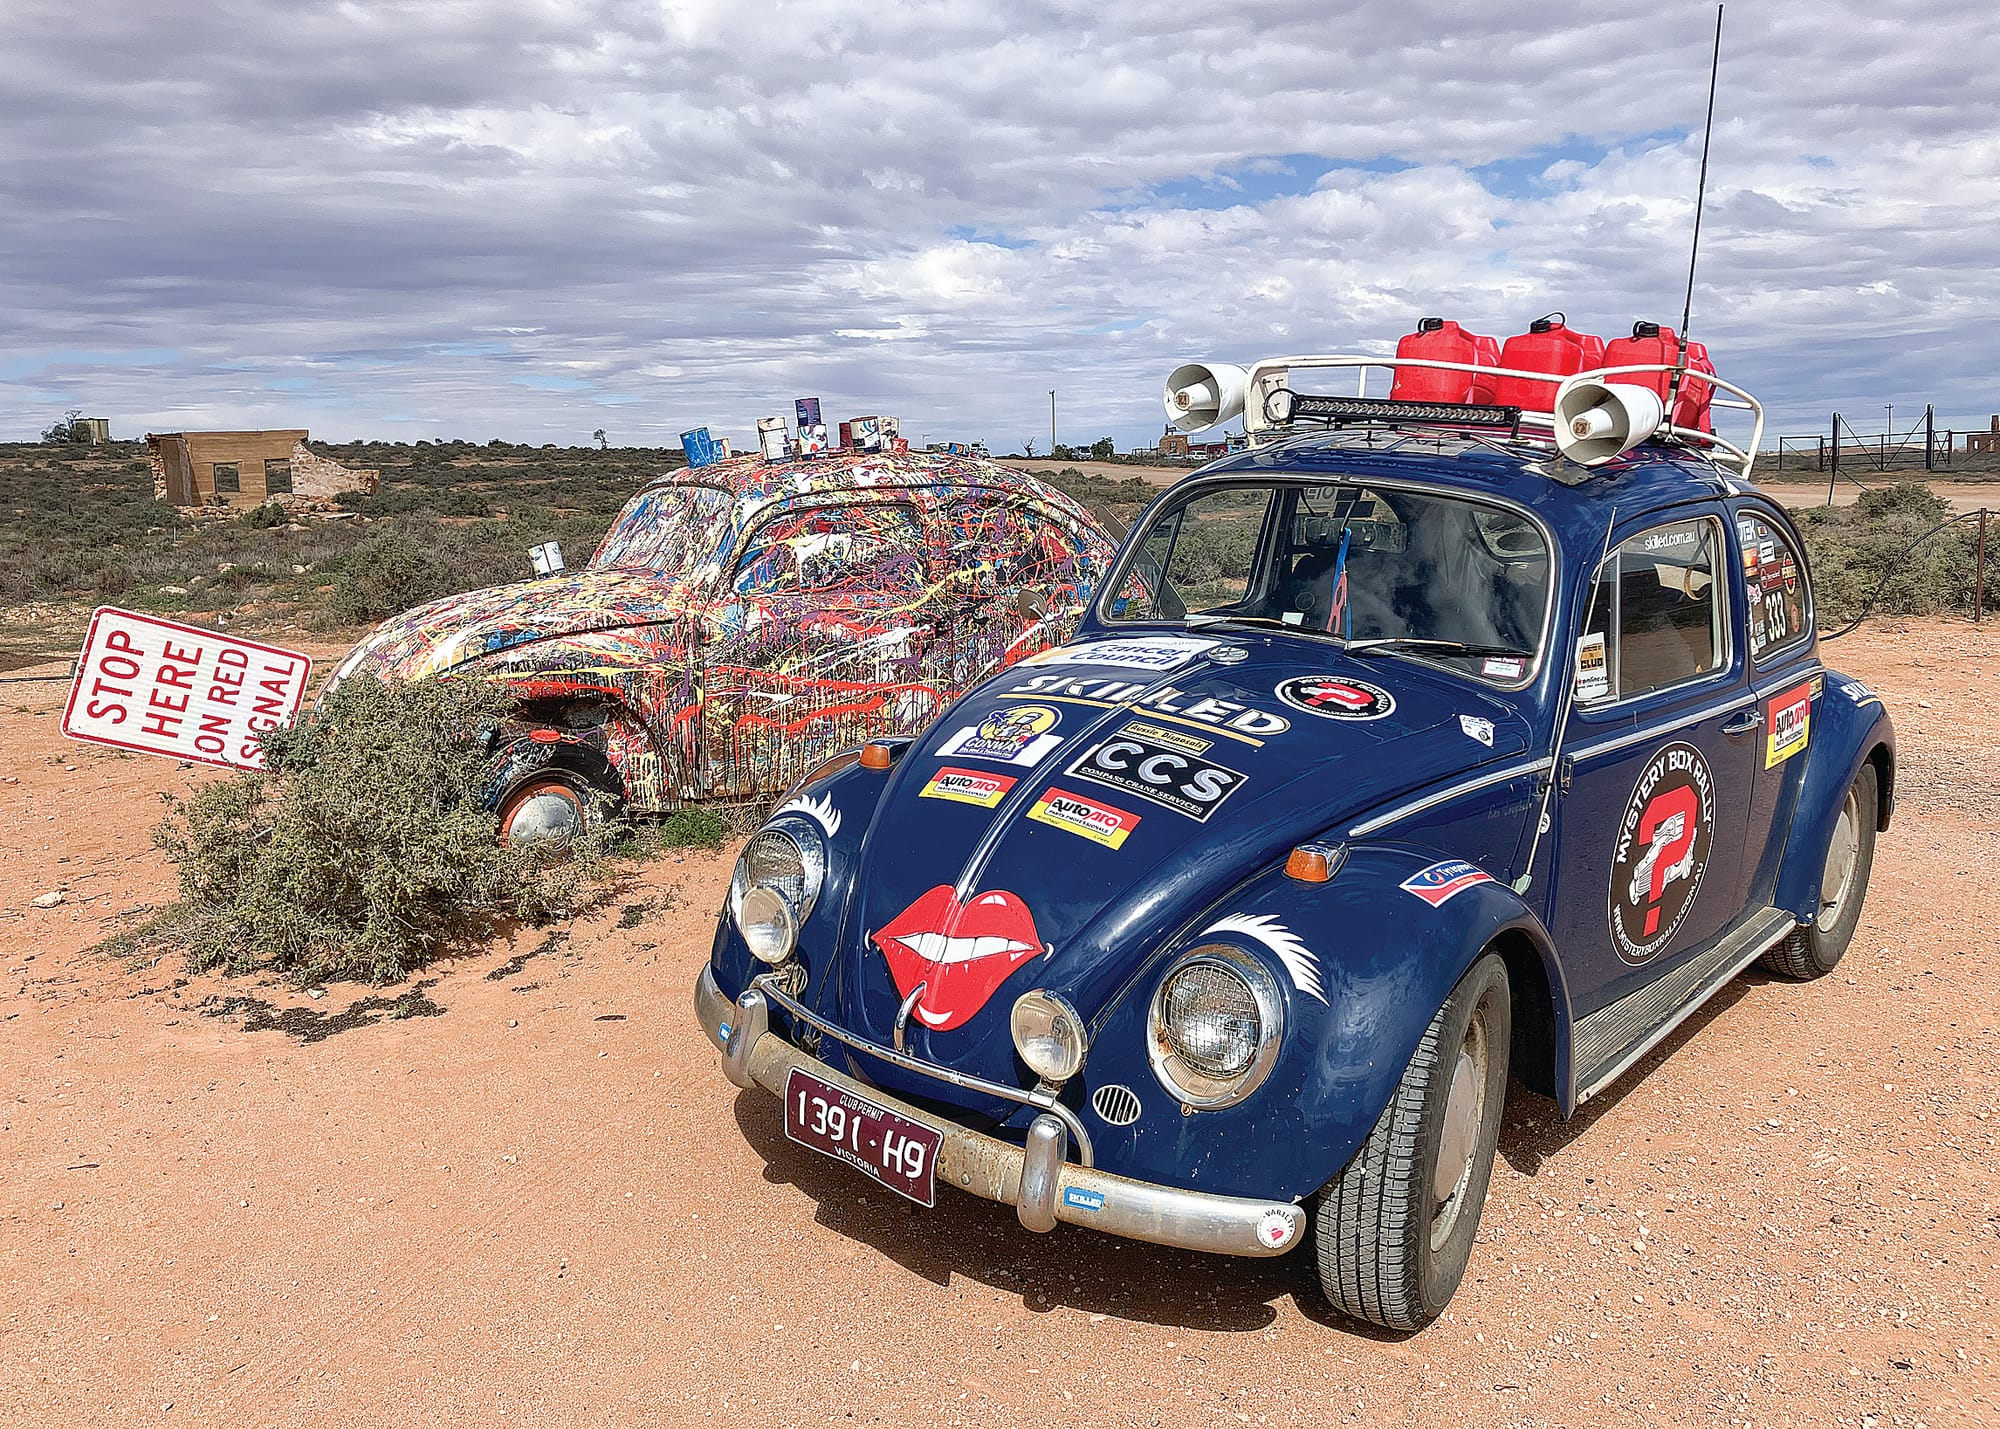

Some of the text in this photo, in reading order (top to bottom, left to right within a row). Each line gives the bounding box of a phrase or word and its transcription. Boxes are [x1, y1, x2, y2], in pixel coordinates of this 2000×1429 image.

[1644, 531, 1695, 551] skilled.com.au
[1765, 591, 1786, 642] 333
[1070, 651, 1180, 665] Council
[1091, 643, 1192, 656] Cancer
[86, 630, 144, 724] STOP
[141, 640, 203, 738] HERE
[194, 649, 249, 754] ON RED
[240, 661, 295, 763] SIGNAL
[1010, 675, 1291, 736] SKILLED
[965, 737, 1024, 752] CONWAY
[1130, 723, 1159, 736] Aussie
[1160, 732, 1203, 749] Disposals
[1079, 766, 1204, 815] COMPASS CRANE SERVICES
[1095, 741, 1234, 801] CCS
[1616, 750, 1714, 864] MYSTERY BOX RALLY
[839, 1094, 885, 1122] CLUB PERMIT
[834, 1145, 881, 1178] VICTORIA
